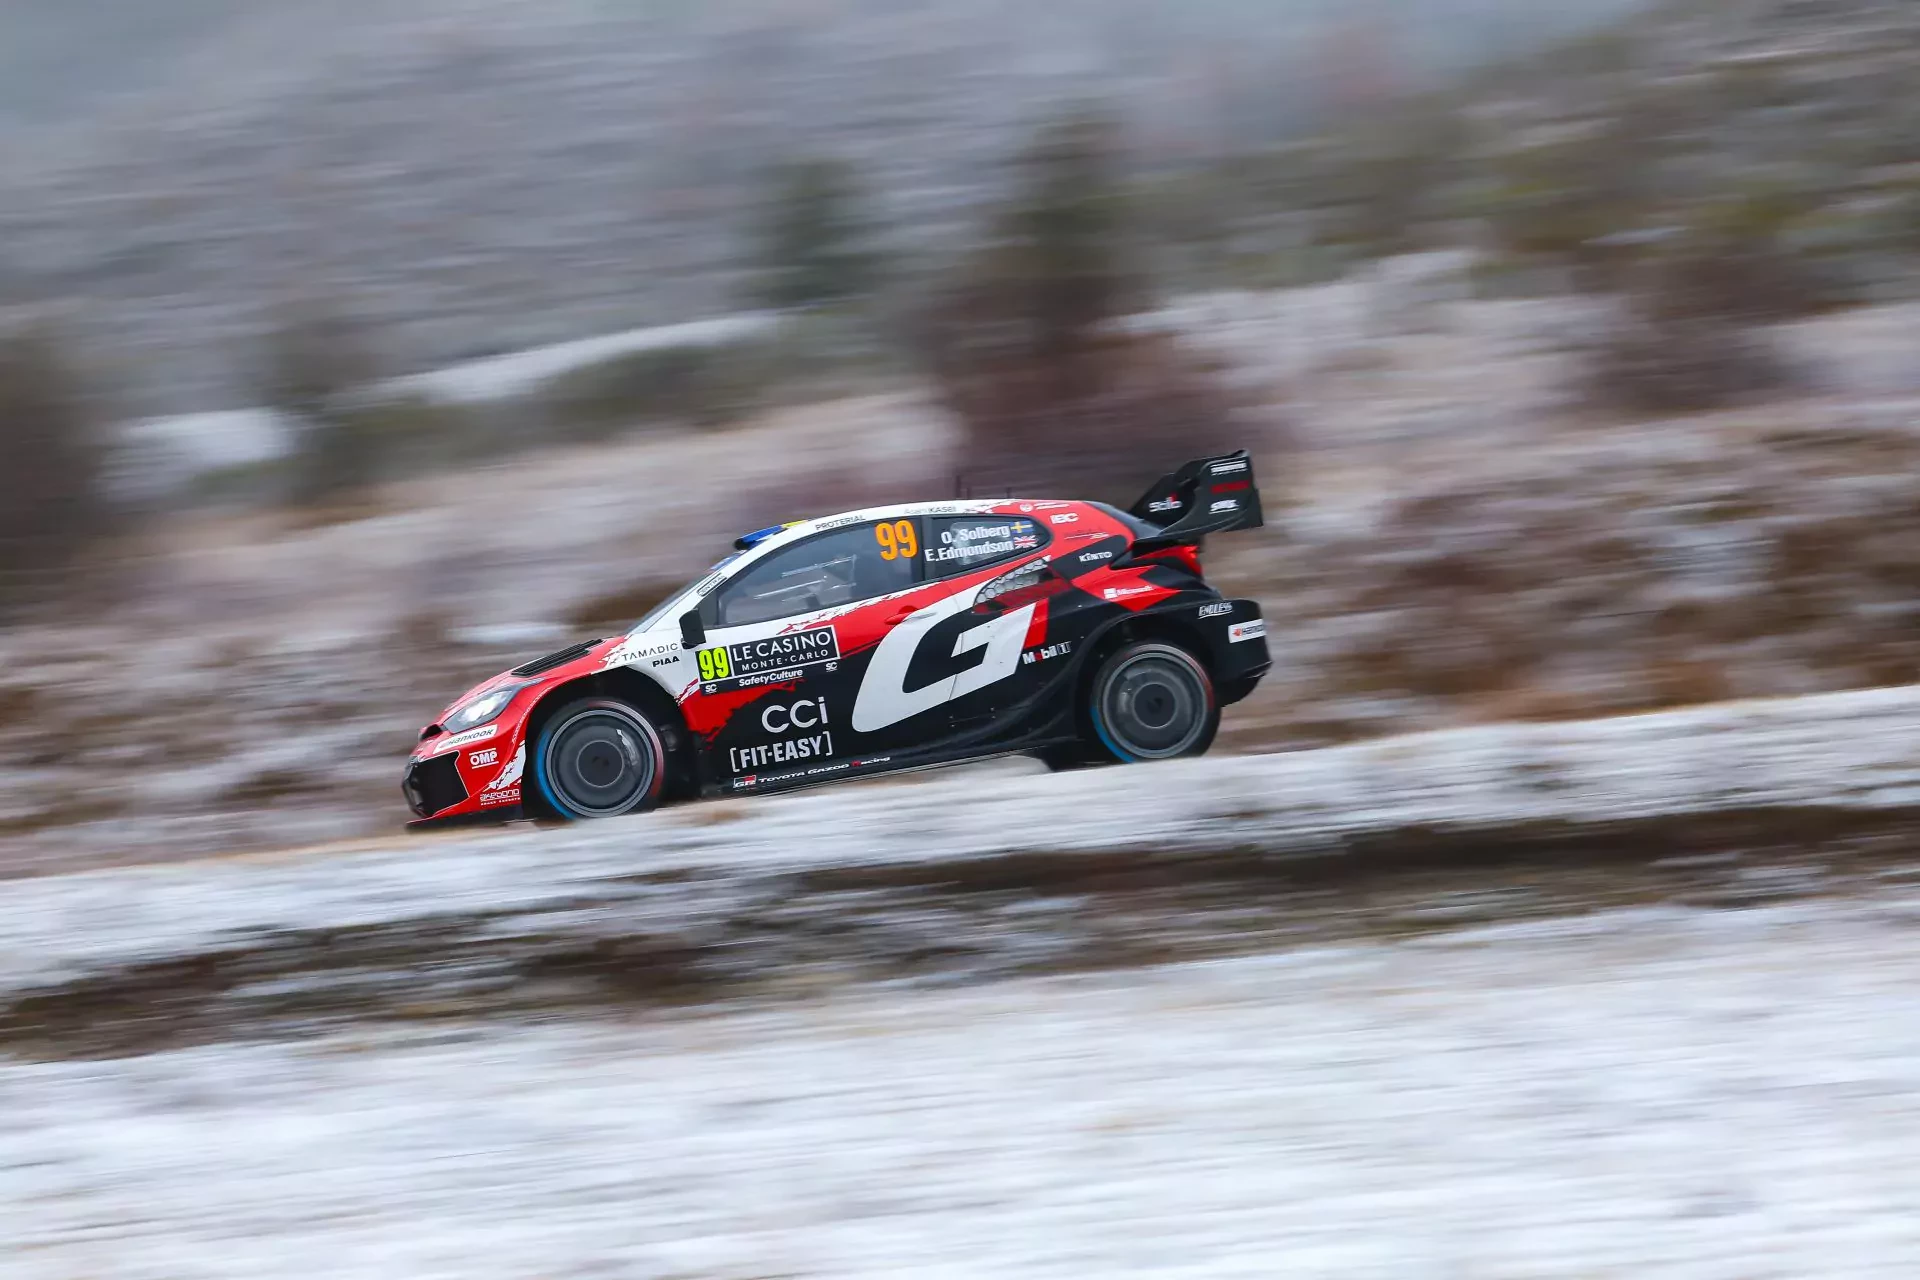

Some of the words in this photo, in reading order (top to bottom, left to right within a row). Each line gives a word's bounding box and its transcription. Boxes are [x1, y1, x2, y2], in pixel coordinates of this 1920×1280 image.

[815, 515, 866, 531] PROTERIAL
[875, 519, 918, 560] 99
[940, 531, 956, 544] O.
[959, 524, 1011, 542] Solberg
[622, 642, 679, 660] TAMADIC
[733, 645, 752, 662] LE
[757, 631, 831, 657] CASINO
[652, 655, 680, 667] PIAA
[698, 647, 731, 681] 99
[739, 669, 804, 687] SafetyCulture
[470, 751, 498, 766] OMP
[758, 772, 805, 784] TOYOTA
